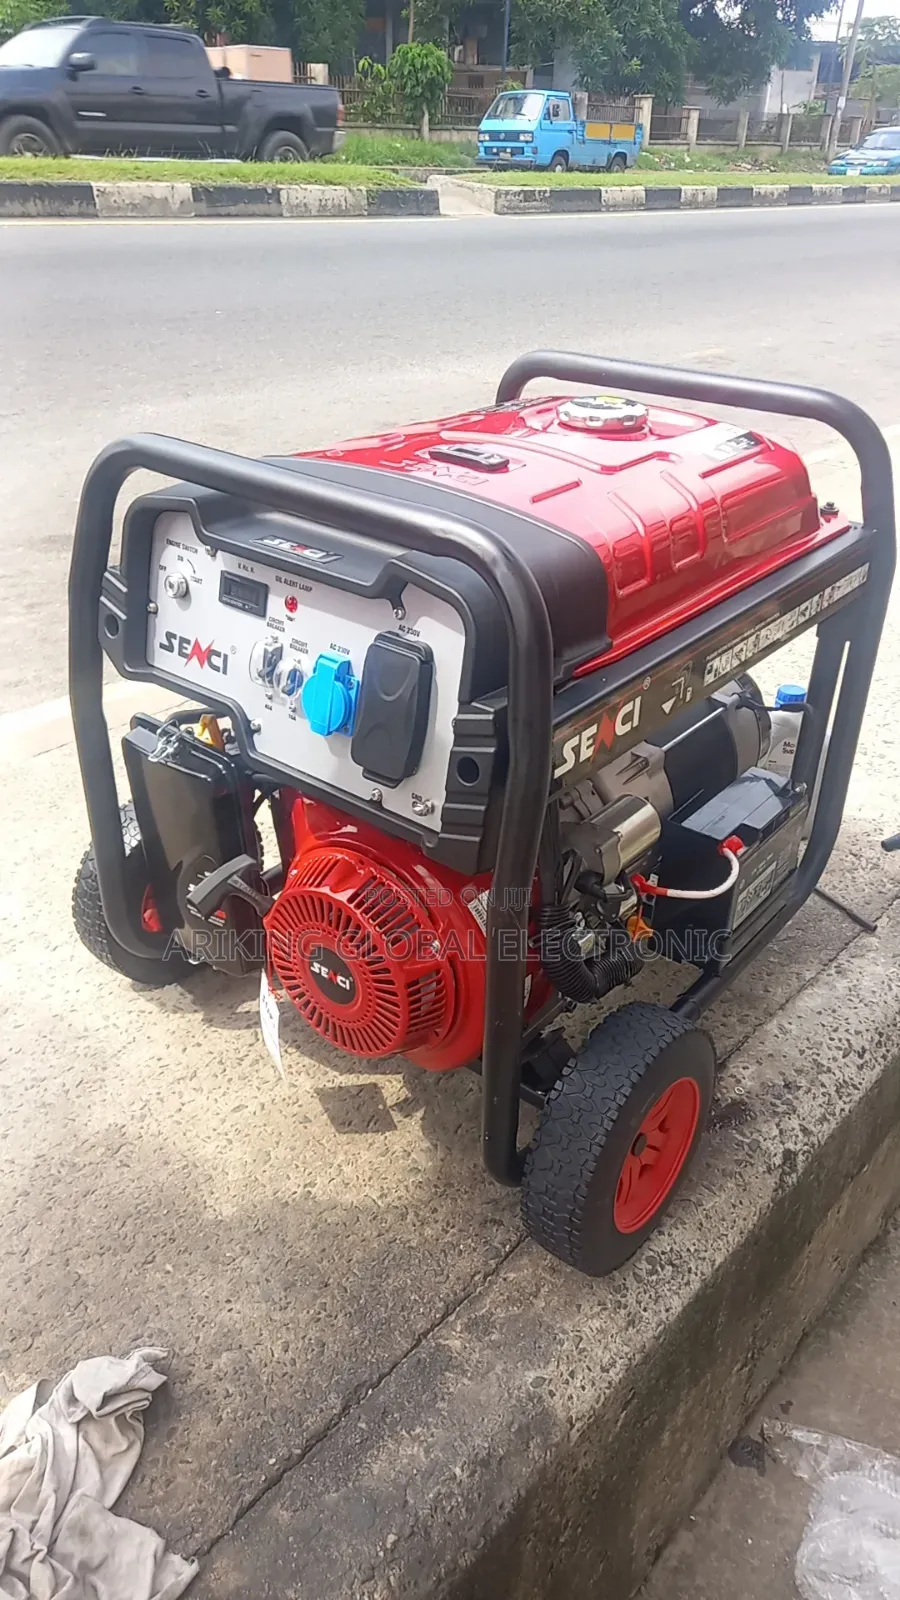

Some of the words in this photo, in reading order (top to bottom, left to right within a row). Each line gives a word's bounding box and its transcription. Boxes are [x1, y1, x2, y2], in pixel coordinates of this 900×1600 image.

[182, 543, 198, 554] SWITCH
[158, 564, 167, 572] OFF
[275, 575, 283, 584] OIL
[284, 577, 299, 589] ALERT
[299, 582, 313, 593] LAMP
[266, 621, 286, 633] BREAKER
[268, 616, 285, 627] CIRCUIT
[398, 624, 406, 633] AC
[406, 626, 421, 638] 230V
[289, 643, 309, 655] BREAKER
[291, 637, 308, 648] CIRCUIT
[329, 642, 337, 651] AC
[337, 645, 351, 656] 230V
[159, 630, 229, 676] SENCI
[553, 695, 642, 780] SENCI
[310, 961, 351, 991] SENCI
